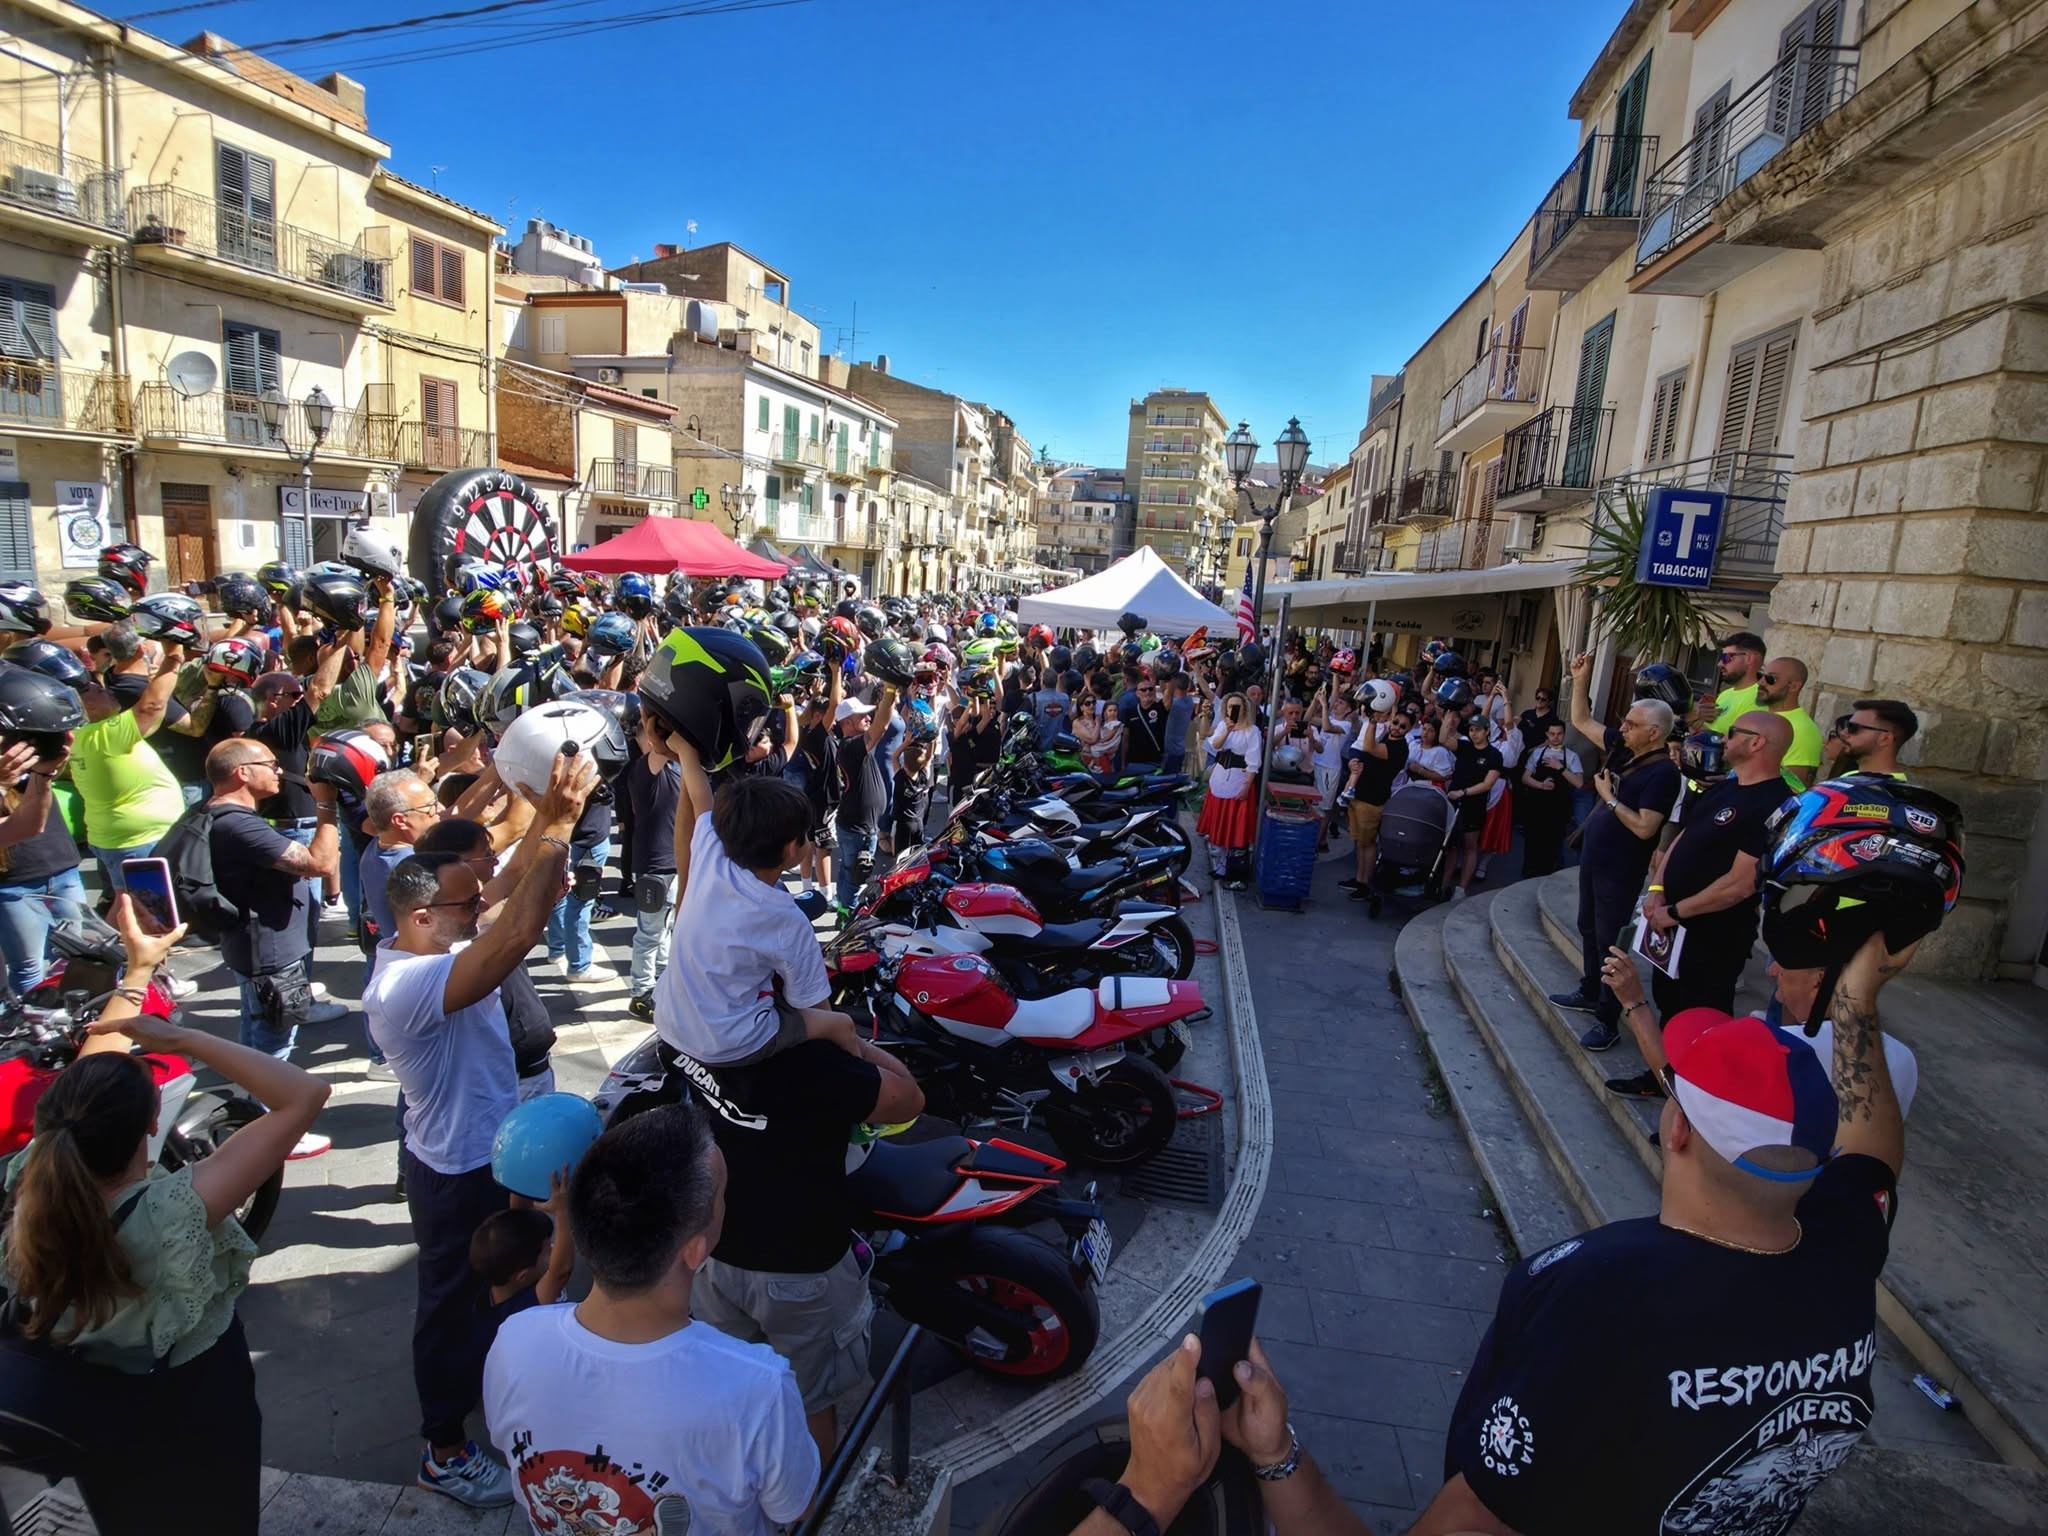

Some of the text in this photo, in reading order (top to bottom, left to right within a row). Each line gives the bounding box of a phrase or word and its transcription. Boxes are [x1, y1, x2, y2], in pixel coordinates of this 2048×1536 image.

[485, 474, 494, 491] 5
[500, 473, 514, 491] 20
[520, 483, 527, 497] 1
[69, 486, 95, 499] VOTA
[465, 483, 481, 502] 12
[285, 491, 363, 512] CffeeTime
[453, 502, 466, 519] 9
[1670, 500, 1712, 559] T
[1653, 562, 1708, 579] TABACCHI
[1362, 617, 1393, 627] Tola
[1845, 803, 1888, 813] Insta360
[1910, 812, 1934, 826] 318
[1757, 1399, 1854, 1448] BIKERS
